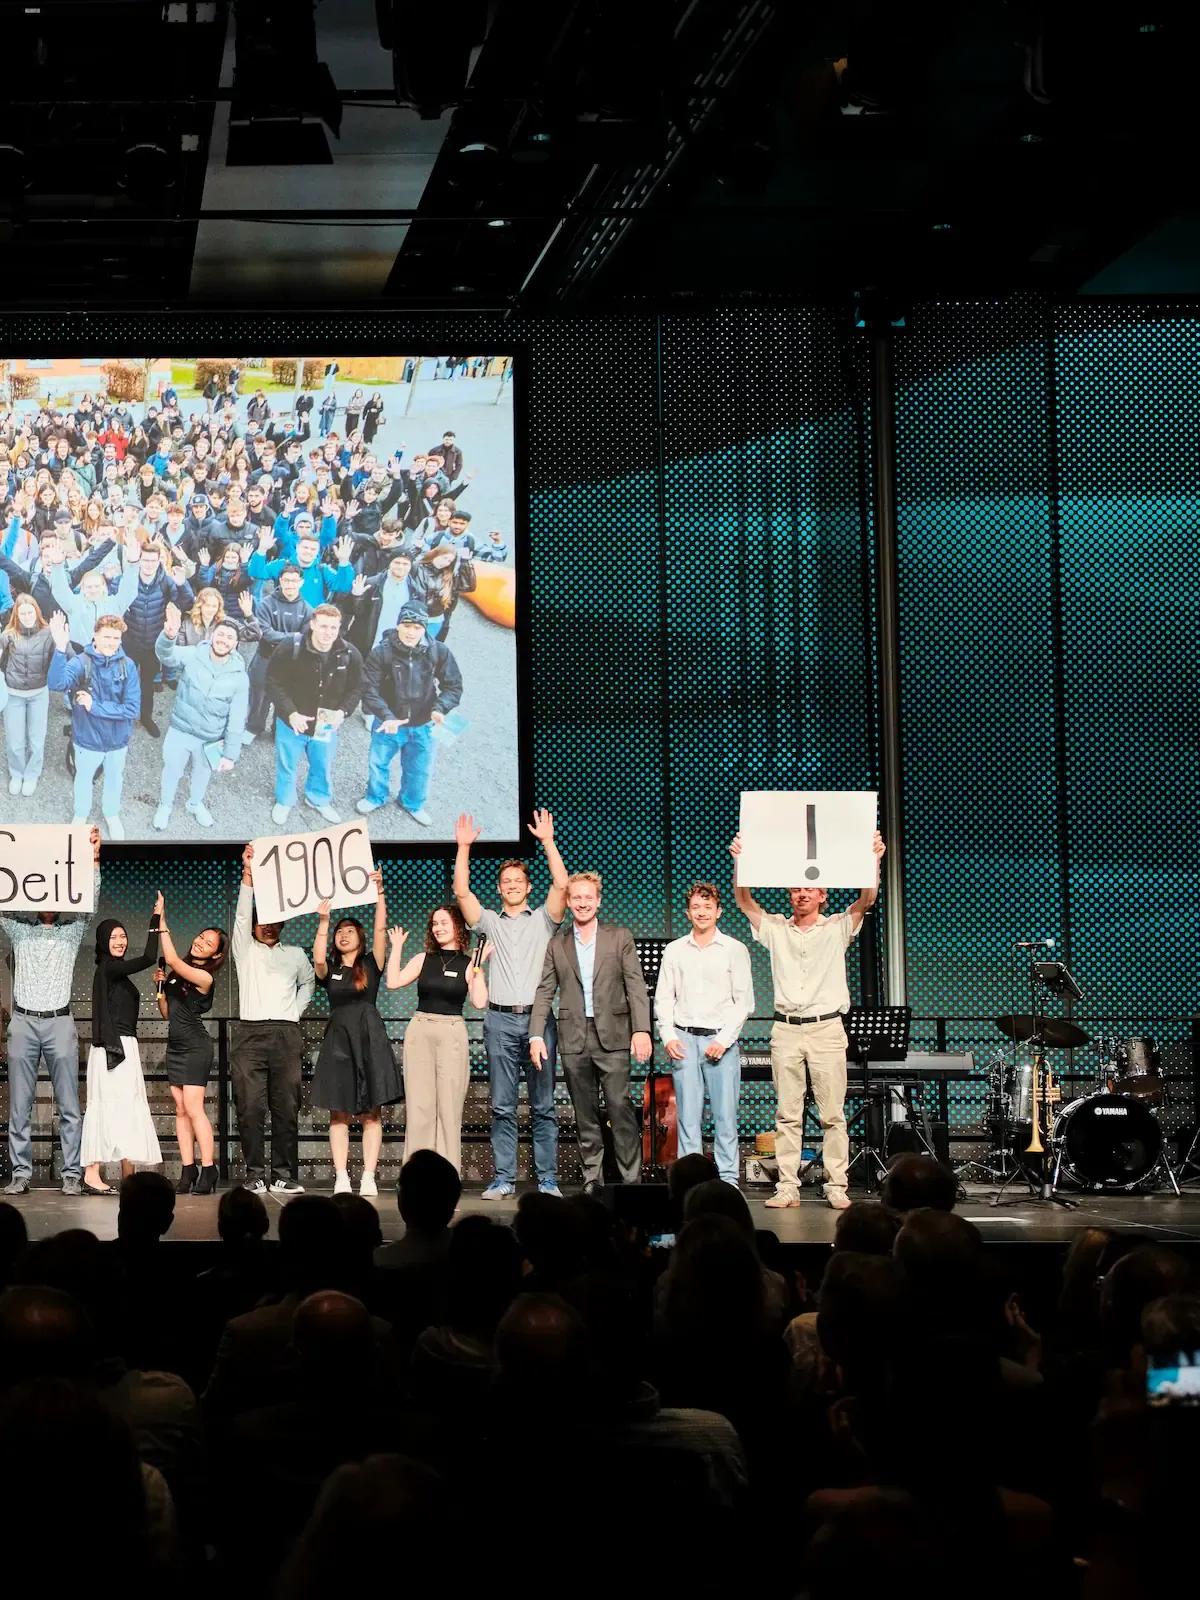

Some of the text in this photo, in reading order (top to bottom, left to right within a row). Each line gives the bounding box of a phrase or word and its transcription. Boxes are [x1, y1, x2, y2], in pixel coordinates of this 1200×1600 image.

[259, 828, 370, 913] 1906
[804, 804, 820, 881] !
[1102, 1107, 1128, 1115] YAMAHA
